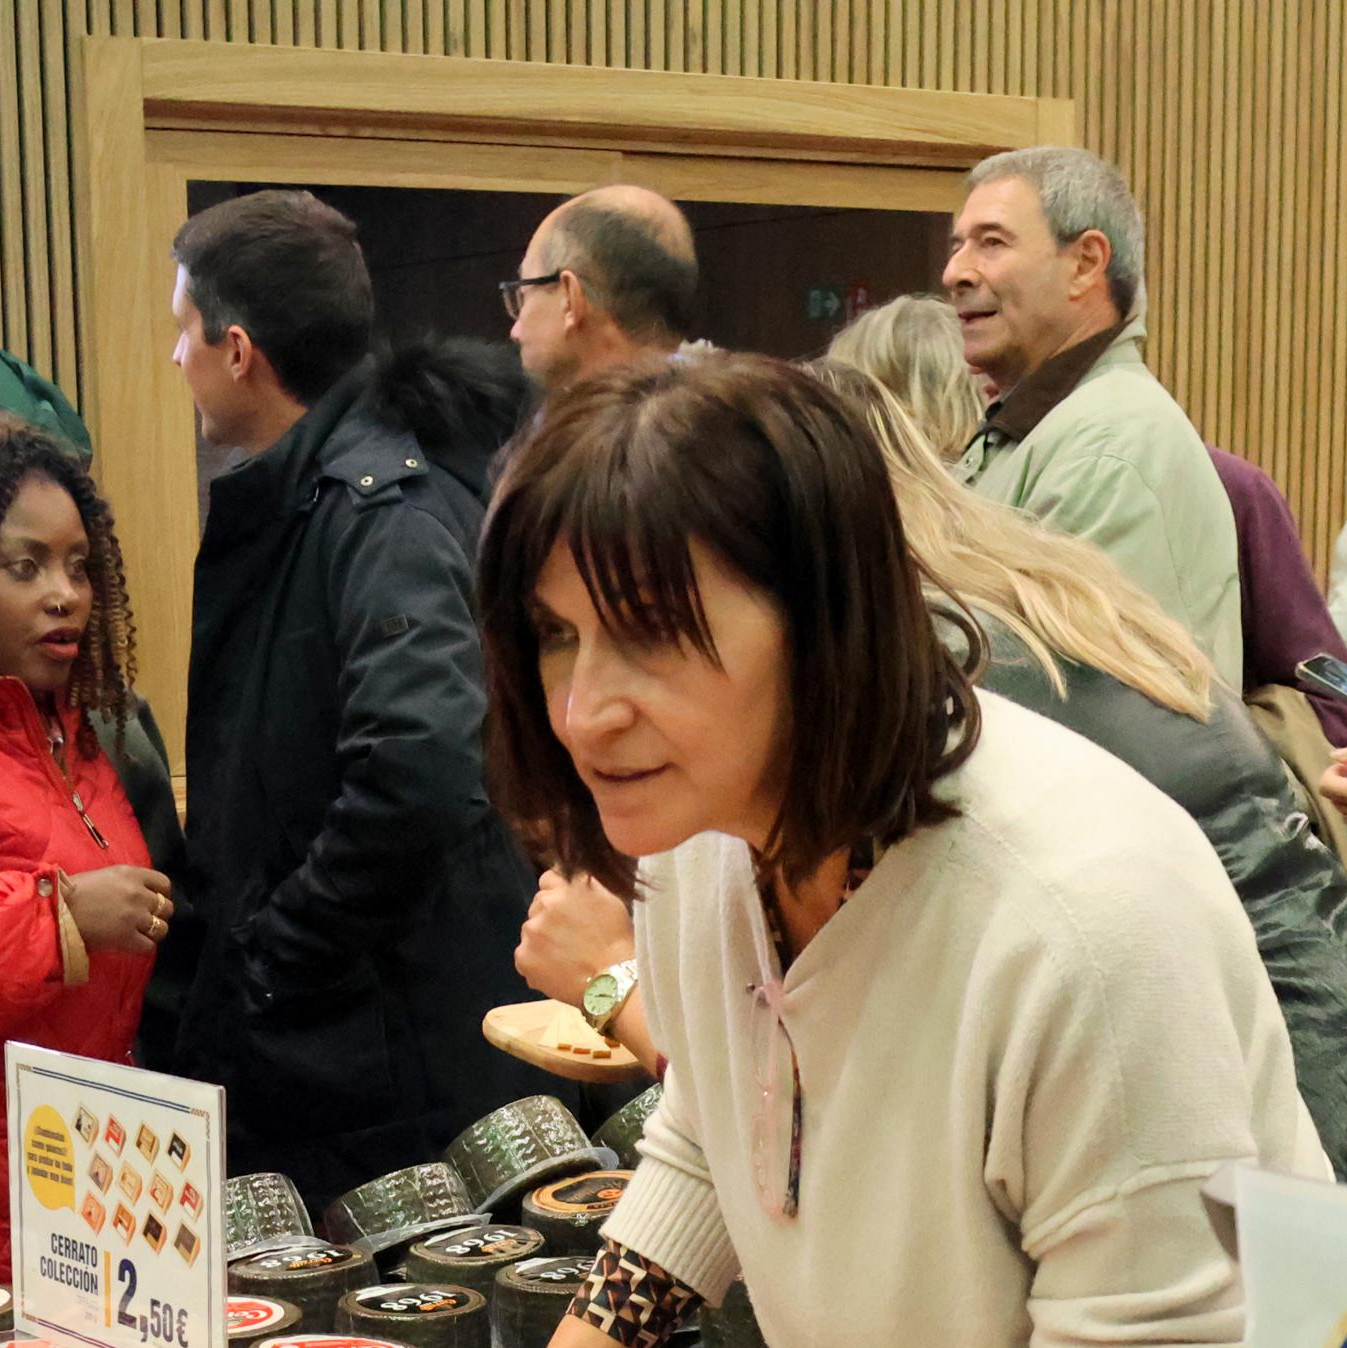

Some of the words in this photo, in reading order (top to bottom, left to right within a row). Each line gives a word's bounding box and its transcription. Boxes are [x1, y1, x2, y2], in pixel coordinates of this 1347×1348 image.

[51, 1233, 99, 1268] CERRATO
[445, 1229, 518, 1254] 1968
[260, 1249, 344, 1269] 1968
[40, 1256, 99, 1295] COLECCIÓN
[381, 1290, 457, 1312] 1968
